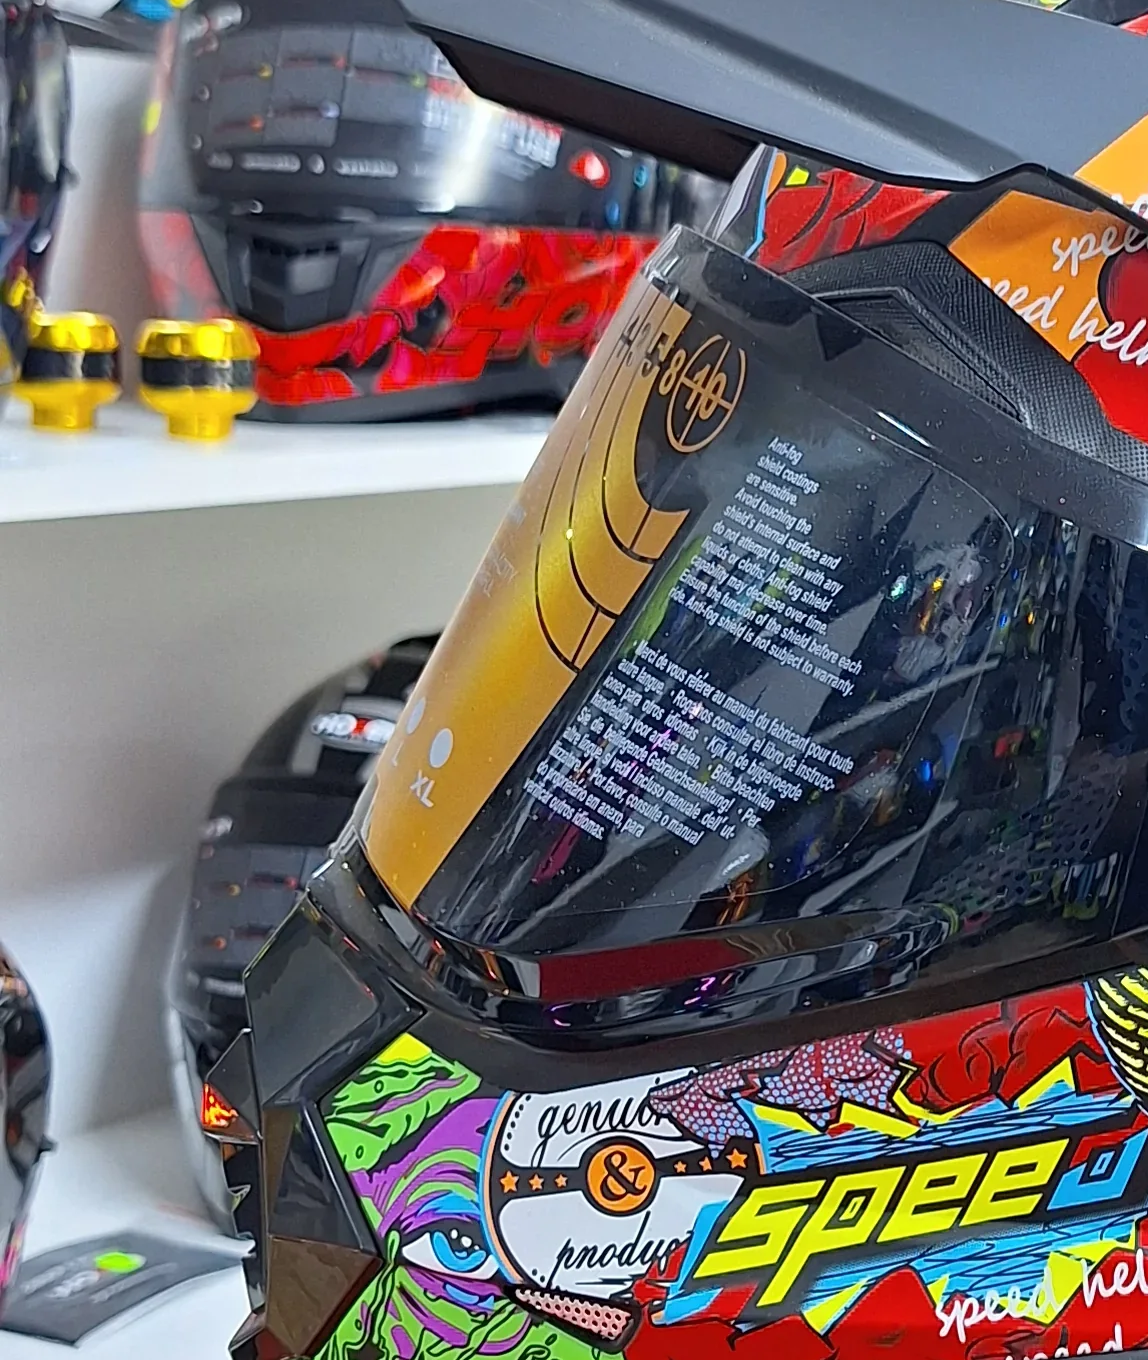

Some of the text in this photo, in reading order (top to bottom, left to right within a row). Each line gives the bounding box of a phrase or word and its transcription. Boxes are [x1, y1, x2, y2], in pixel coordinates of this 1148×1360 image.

[658, 348, 687, 396] 8
[757, 454, 819, 494] shield coatings
[767, 436, 802, 465] Anti-fog
[734, 487, 811, 534] Avoid touching the
[745, 472, 797, 506] are sensitive.
[712, 519, 843, 596] do not attempt to clean with any
[723, 504, 755, 528] shield's
[785, 538, 820, 561] surface
[819, 553, 842, 569] and
[690, 554, 827, 635] capability may decrease over time.
[700, 535, 729, 560] liquids
[727, 553, 740, 565] or
[765, 571, 802, 601] Anti-fog
[800, 589, 833, 612] shield
[667, 585, 685, 604] ride.
[684, 594, 719, 625] Anti-fog
[717, 615, 747, 638] shield
[751, 632, 771, 651] not
[768, 643, 804, 669] subject
[801, 659, 812, 674] to
[812, 666, 854, 697] warranty.
[678, 567, 862, 675] Ensure the function of the shield before each
[619, 687, 642, 706] para
[641, 699, 664, 720] otros
[663, 709, 698, 740] idiomas
[706, 735, 727, 758] Kijk
[724, 745, 736, 763] in
[734, 753, 748, 770] de
[746, 758, 802, 801] bijgevoegde
[654, 652, 668, 670] de
[665, 661, 687, 682] vous
[711, 689, 726, 705] au
[722, 696, 759, 723] manuel
[754, 711, 770, 730] du
[766, 717, 810, 752] fabricant
[803, 742, 831, 762] pour
[828, 749, 853, 774] toute
[711, 715, 754, 746] consultar
[751, 737, 765, 753] el
[760, 740, 784, 764] libro
[782, 753, 796, 772] de
[410, 769, 436, 808] XL
[576, 705, 591, 725] Sie
[590, 716, 604, 734] die
[646, 750, 735, 814] Gebrauchsanleitung!
[740, 807, 761, 827] Per
[631, 718, 653, 738] voor
[648, 729, 678, 754] andere
[676, 744, 700, 769] talen.
[710, 763, 734, 787] Bitte
[731, 774, 775, 811] beachten
[631, 767, 664, 797] incluso
[661, 790, 701, 819] manuale
[536, 760, 548, 775] do
[584, 793, 600, 810] em
[596, 801, 623, 828] anexo,
[620, 817, 644, 837] para
[548, 796, 575, 819] outros
[571, 807, 604, 840] idiomas.
[625, 793, 662, 822] consulte
[666, 818, 704, 845] manual
[599, 1149, 650, 1202] &
[934, 1265, 1064, 1343] speed
